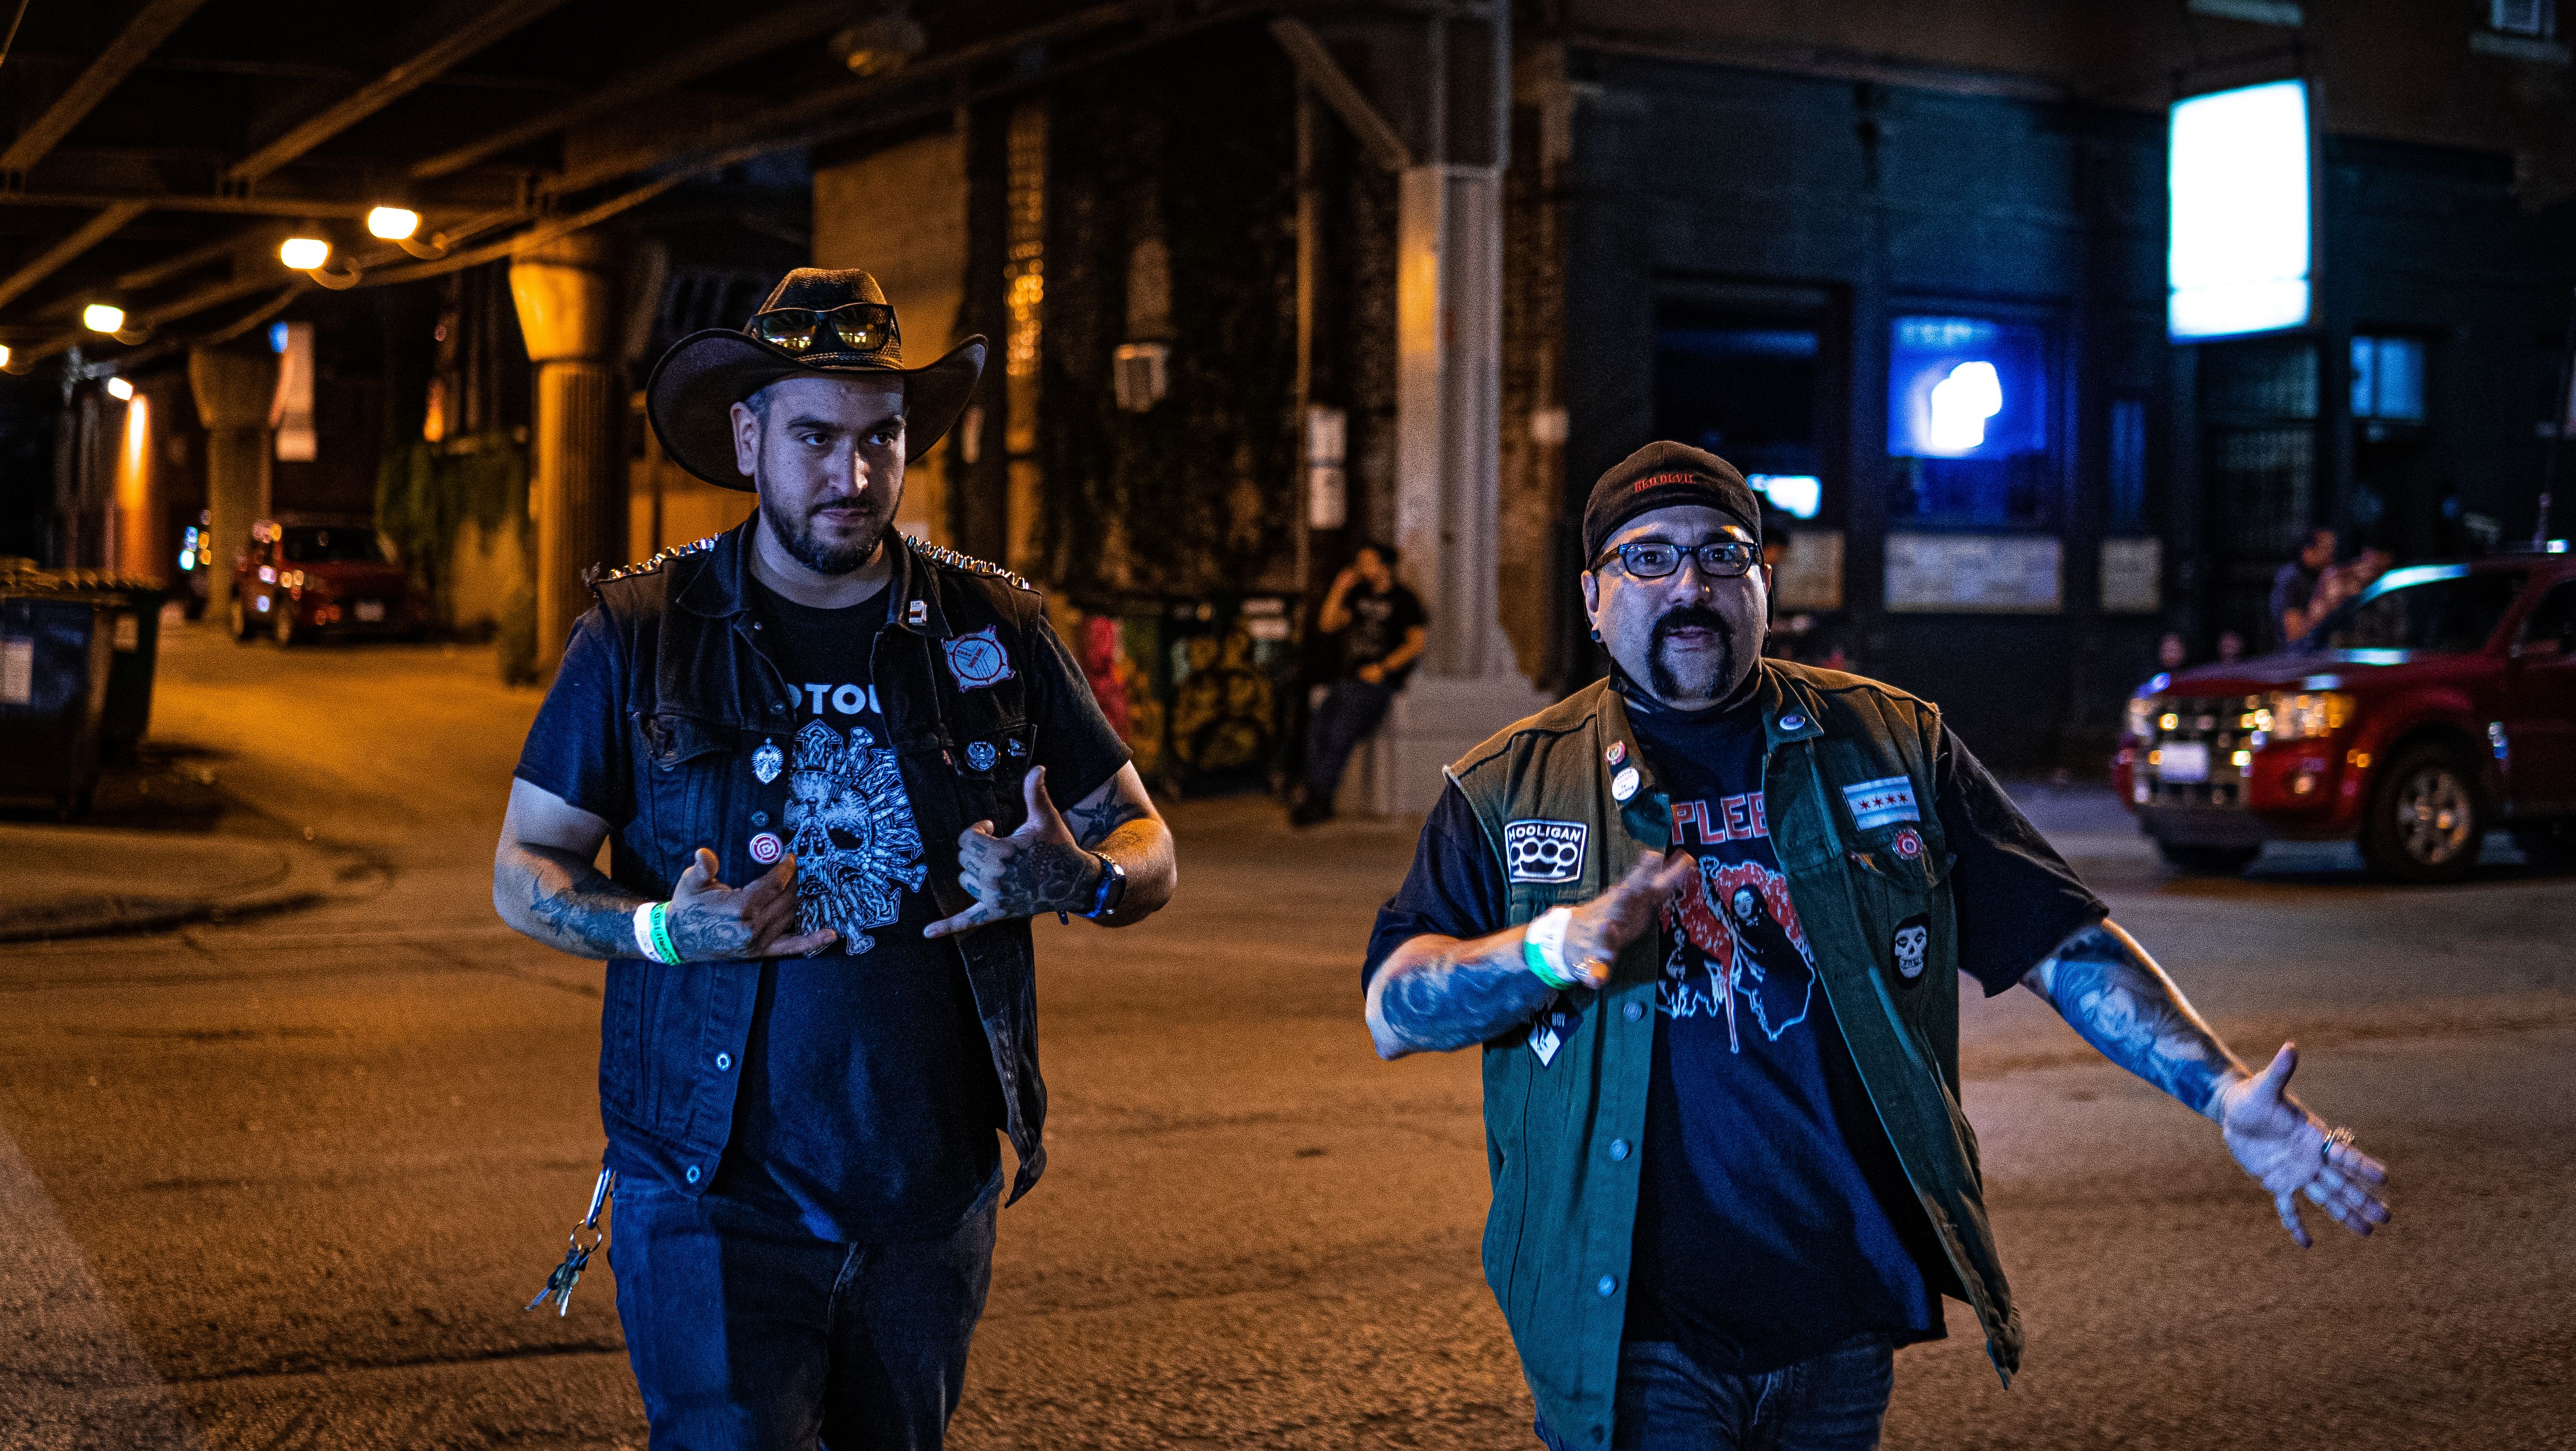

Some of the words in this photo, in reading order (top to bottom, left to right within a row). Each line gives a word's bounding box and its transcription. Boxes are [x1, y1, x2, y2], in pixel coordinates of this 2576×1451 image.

[1634, 477, 1657, 493] RED
[1660, 473, 1697, 484] DEVIL
[1508, 824, 1582, 843] HOOLIGAN
